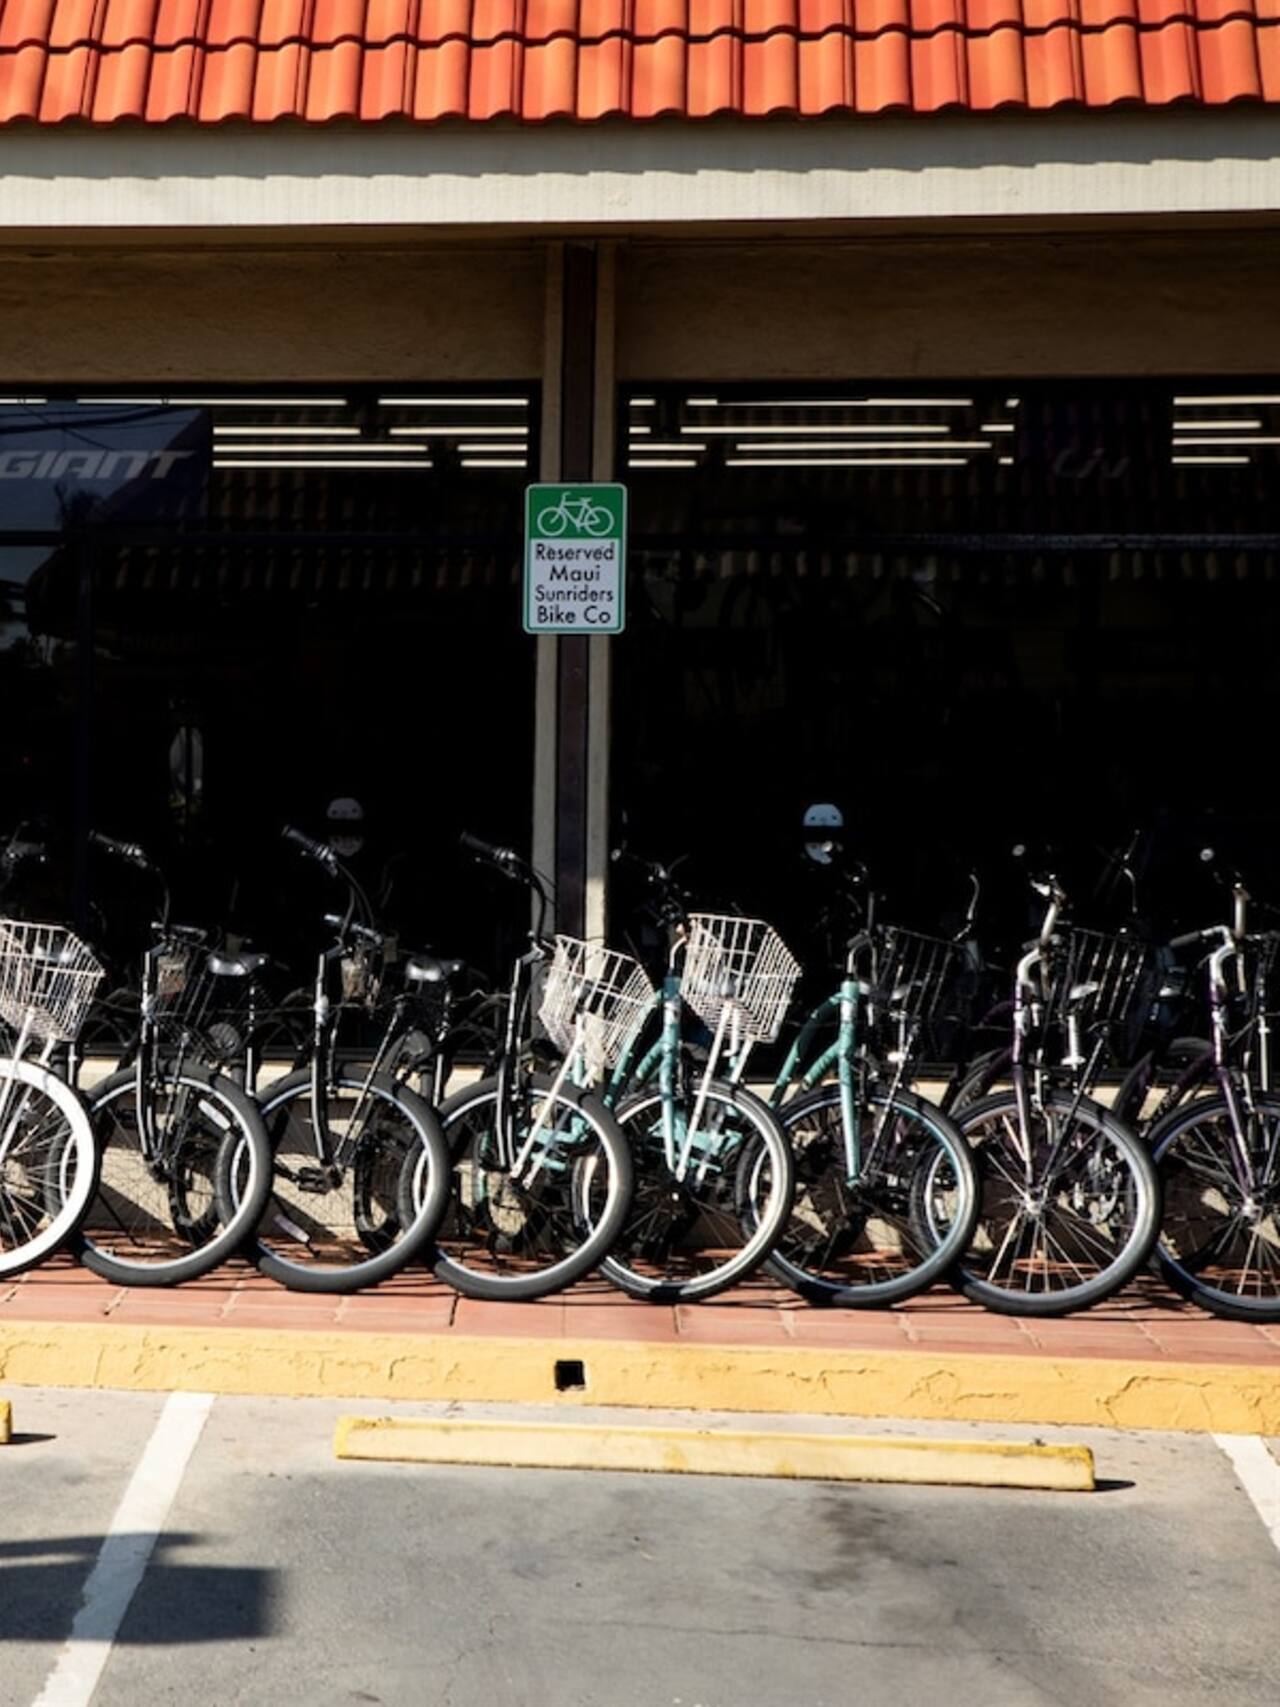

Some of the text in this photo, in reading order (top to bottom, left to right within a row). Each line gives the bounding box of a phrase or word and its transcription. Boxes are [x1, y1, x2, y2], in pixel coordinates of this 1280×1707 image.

[535, 542, 615, 561] Reserved
[549, 565, 601, 582] Maui
[534, 584, 614, 602] Sunriders
[536, 605, 612, 624] Bike Co
